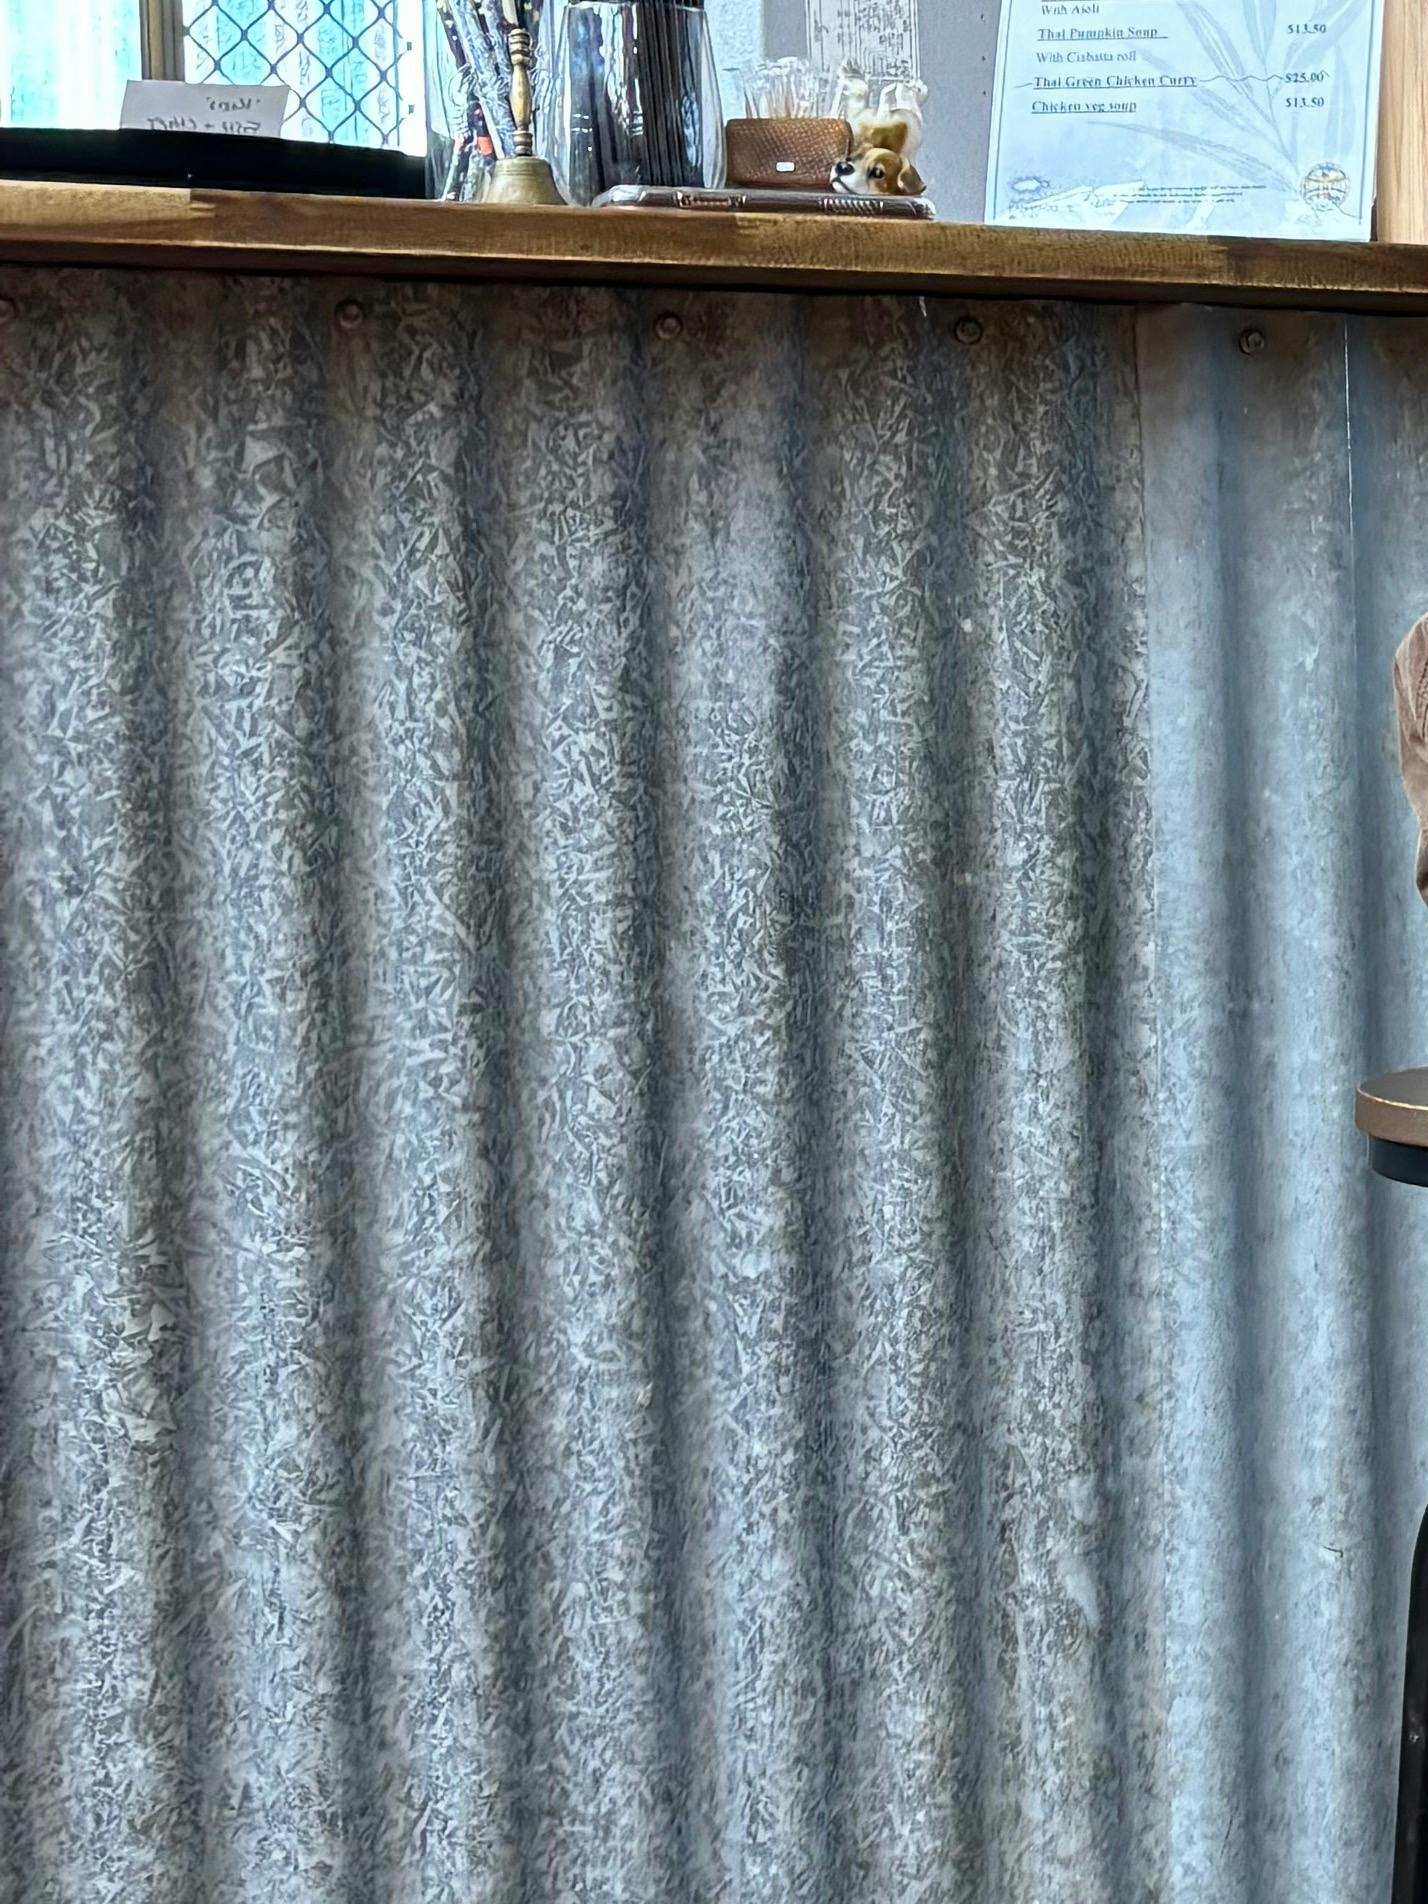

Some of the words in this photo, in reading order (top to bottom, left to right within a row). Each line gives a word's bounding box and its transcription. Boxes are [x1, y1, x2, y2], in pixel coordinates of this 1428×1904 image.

[1038, 28, 1067, 41] Thai
[1036, 52, 1064, 64] With
[1033, 76, 1062, 89] Thai
[1064, 75, 1102, 89] Green
[1105, 75, 1156, 89] Chicken
[1158, 74, 1198, 88] Curry
[1032, 100, 1083, 114] Chicken
